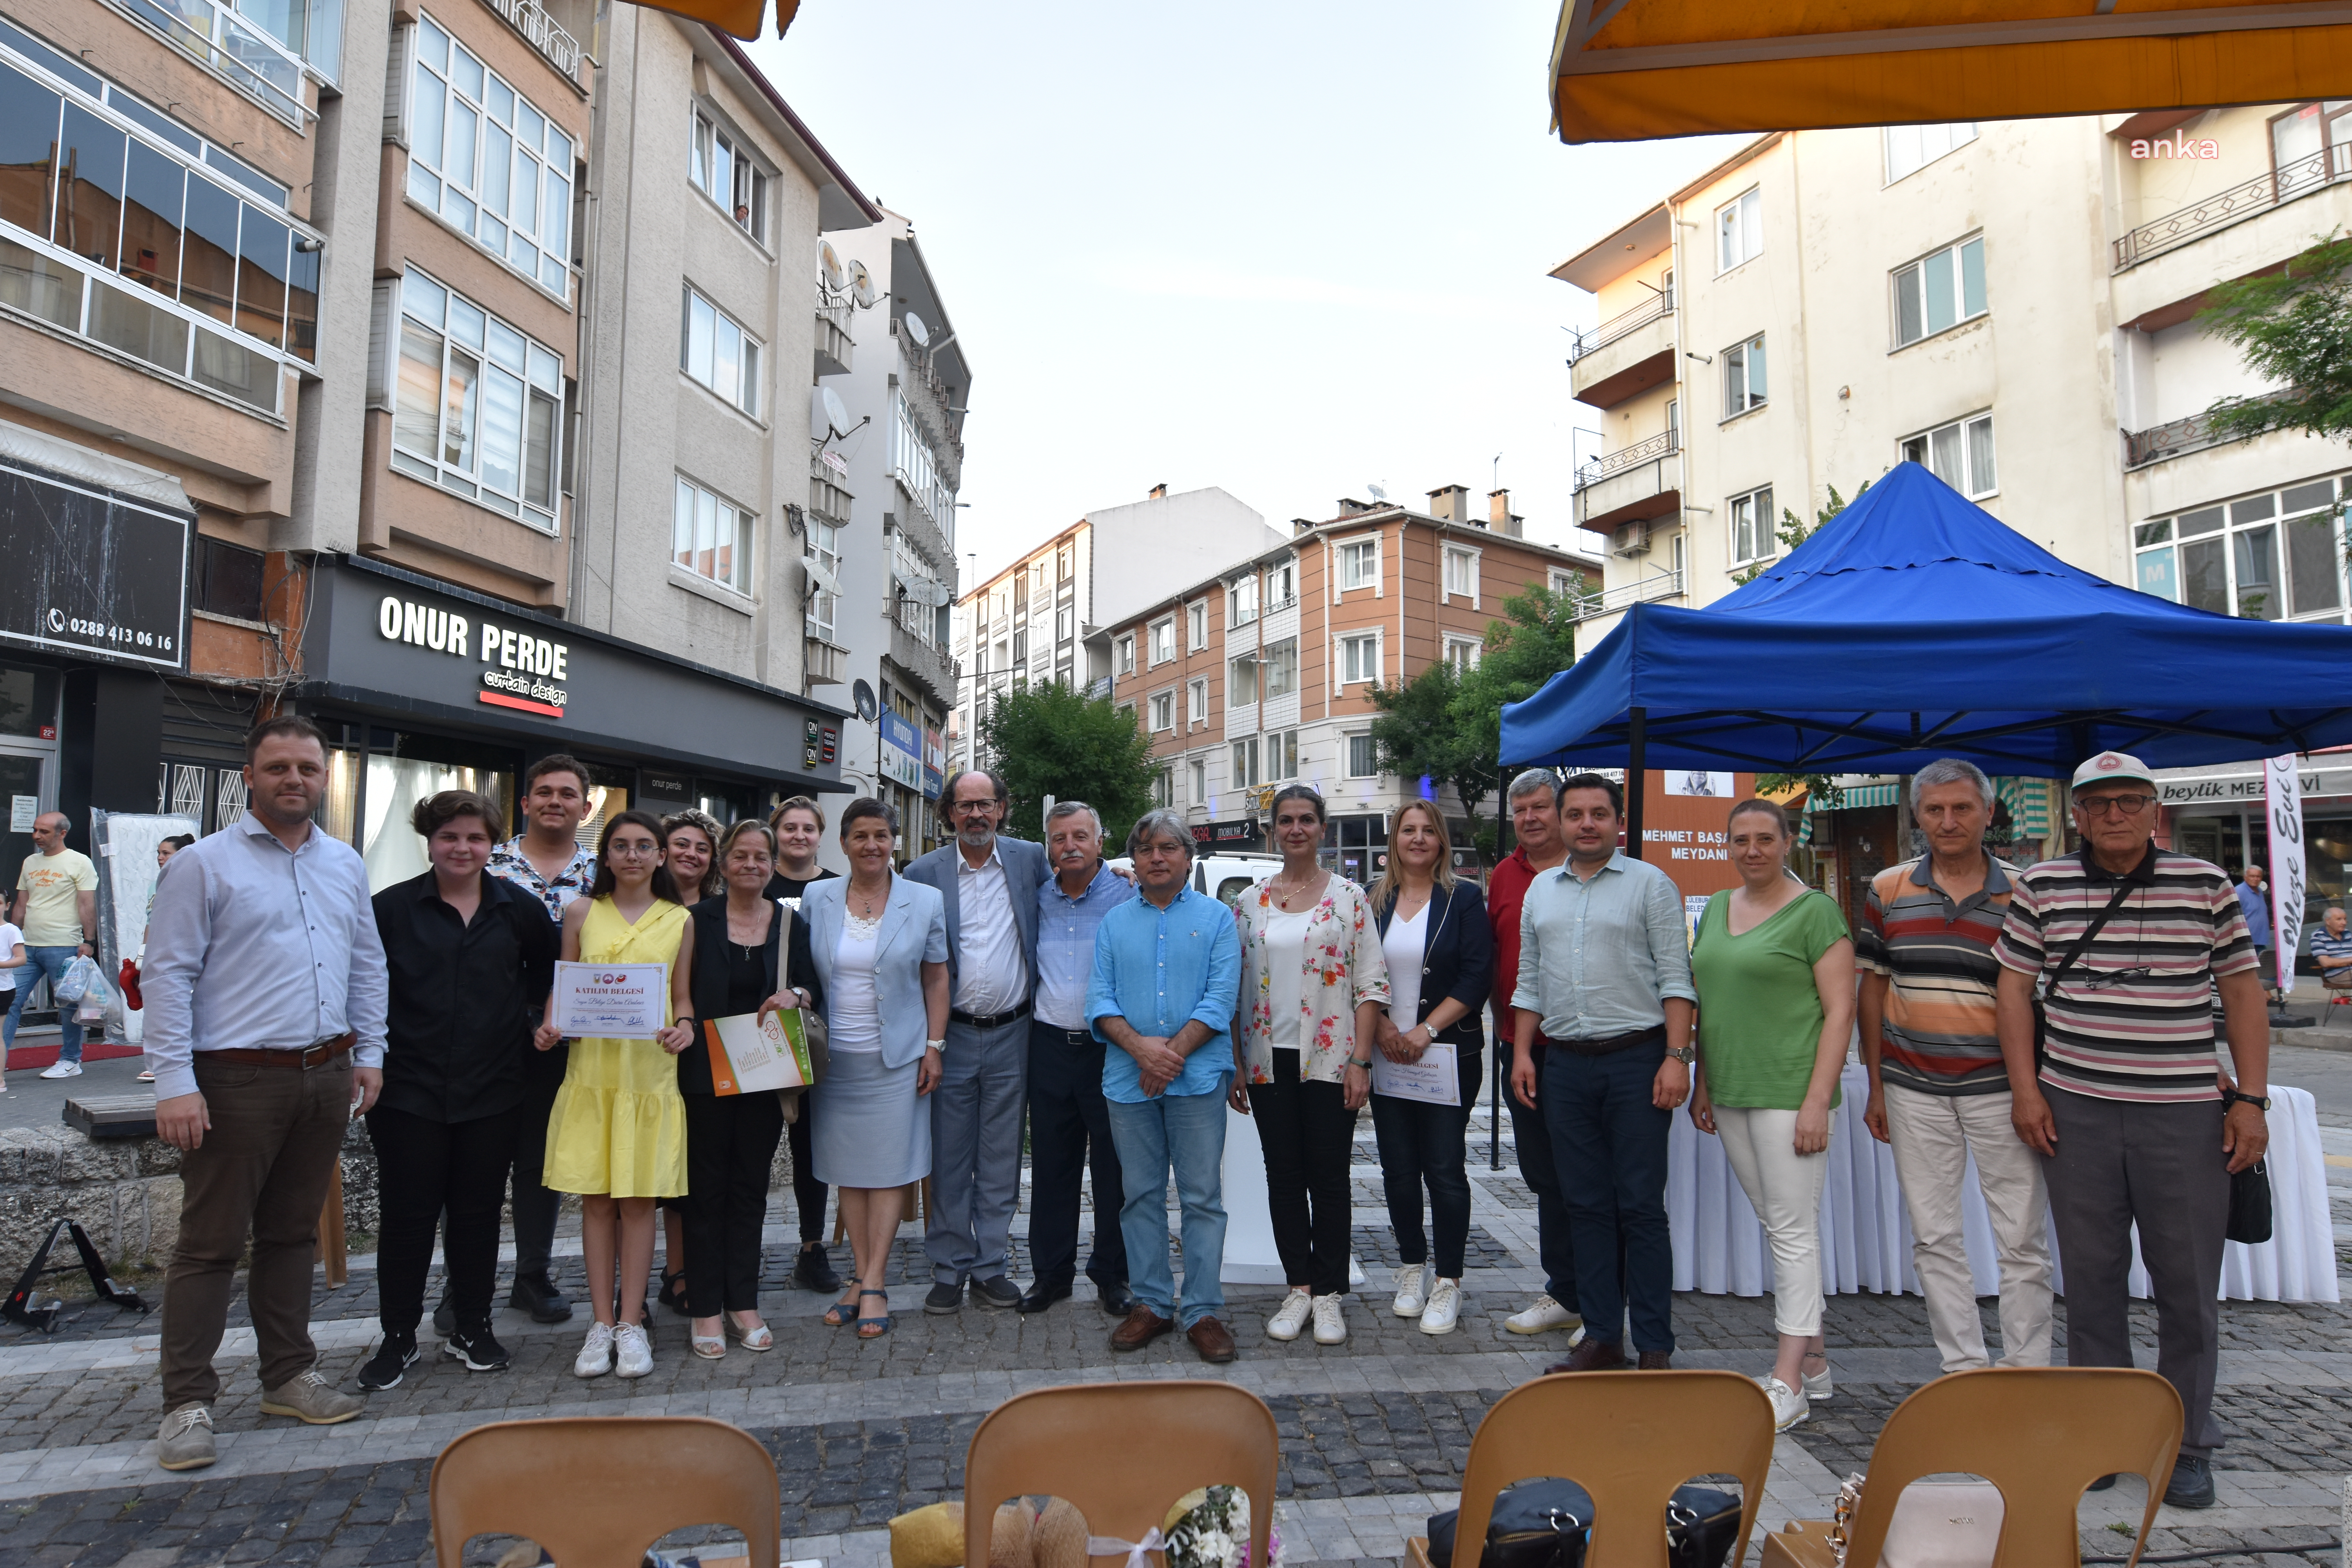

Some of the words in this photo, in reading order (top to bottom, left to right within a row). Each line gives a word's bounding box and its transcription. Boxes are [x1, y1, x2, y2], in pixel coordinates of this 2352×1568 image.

[71, 618, 104, 637] 0288
[108, 626, 132, 642] 413
[137, 631, 152, 646] 06
[158, 635, 171, 650] 16
[380, 597, 468, 656] ONUR
[481, 623, 567, 681] PERDE
[485, 670, 529, 695] curtain
[531, 678, 567, 707] design
[808, 722, 818, 732] ON
[893, 719, 913, 747] HYUNDAI
[807, 748, 816, 758] ON
[666, 781, 682, 790] perde
[2163, 782, 2224, 801] beylik
[2231, 781, 2266, 796] MEZ
[2299, 775, 2321, 791] Vİ
[2275, 778, 2299, 844] Evi
[1218, 826, 1241, 837] MOBİLYA
[1243, 822, 1249, 838] 2
[1642, 829, 1693, 842] MEHMET
[1698, 831, 1728, 847] BAŞA
[1984, 825, 2013, 843] ski
[1671, 848, 1728, 860] MEYDANI
